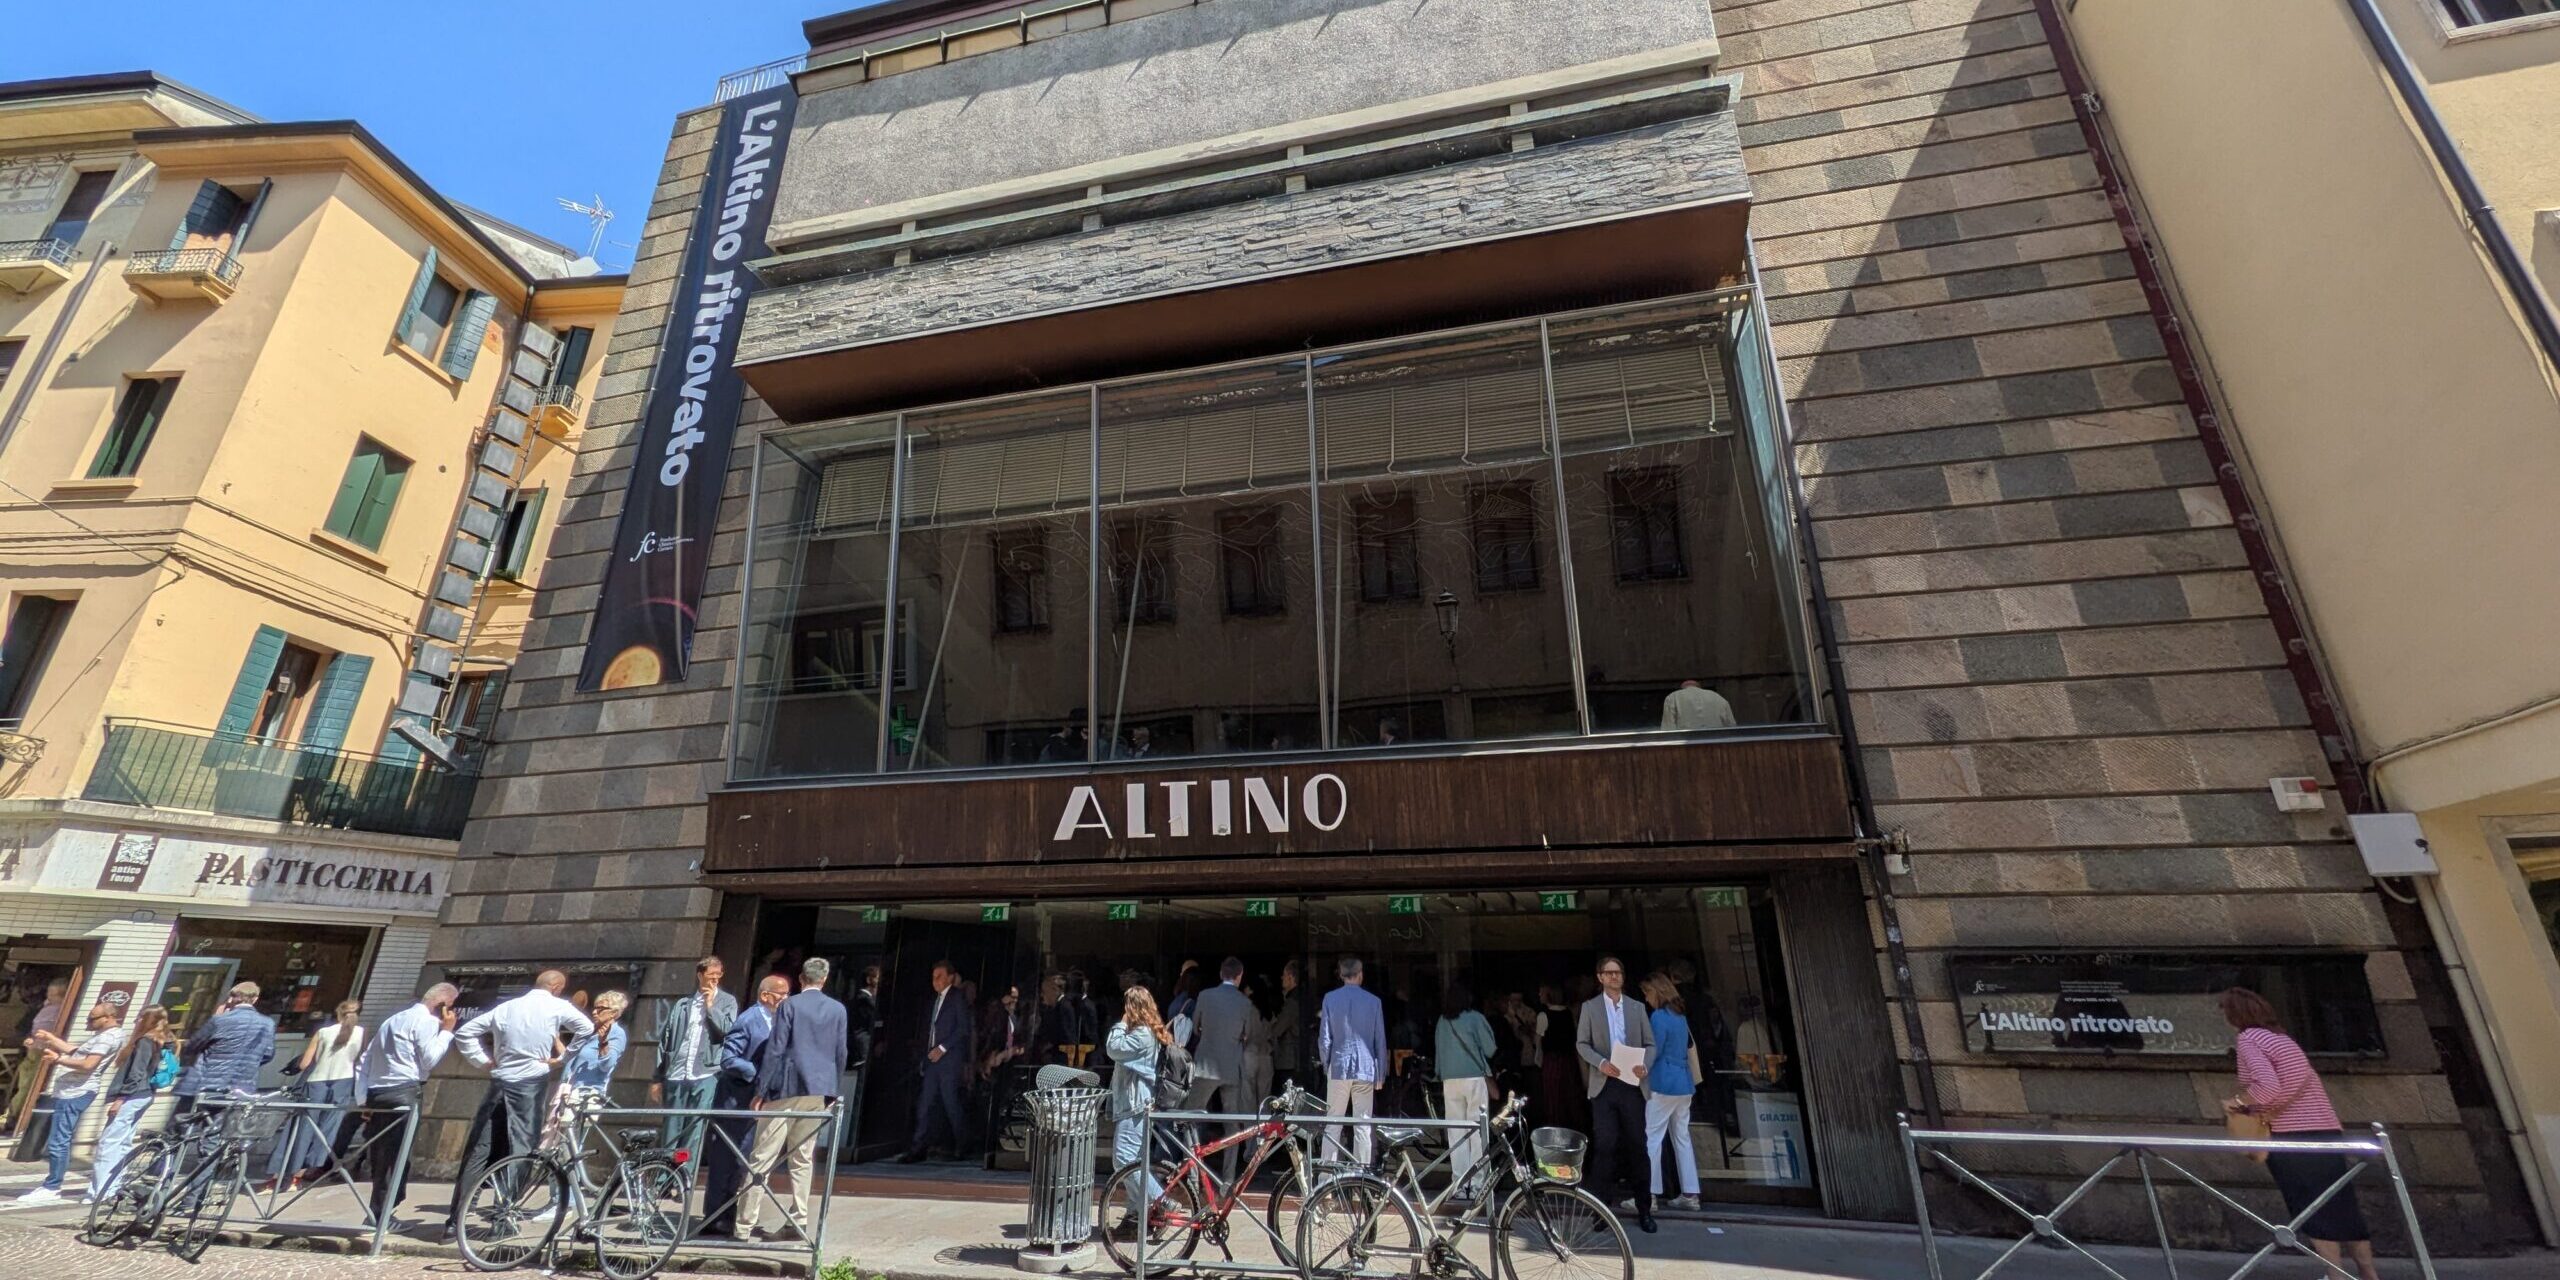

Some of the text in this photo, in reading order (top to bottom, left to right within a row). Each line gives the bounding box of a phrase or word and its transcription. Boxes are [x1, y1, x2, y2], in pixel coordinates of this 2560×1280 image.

[712, 100, 782, 262] L’Altino
[660, 268, 743, 487] ritrovato
[1053, 773, 1347, 840] ALTINO
[109, 874, 135, 882] forno
[111, 865, 141, 874] antico
[195, 852, 434, 895] PASTICCERIA
[1980, 1012, 2174, 1034] L’Altino ritrovato
